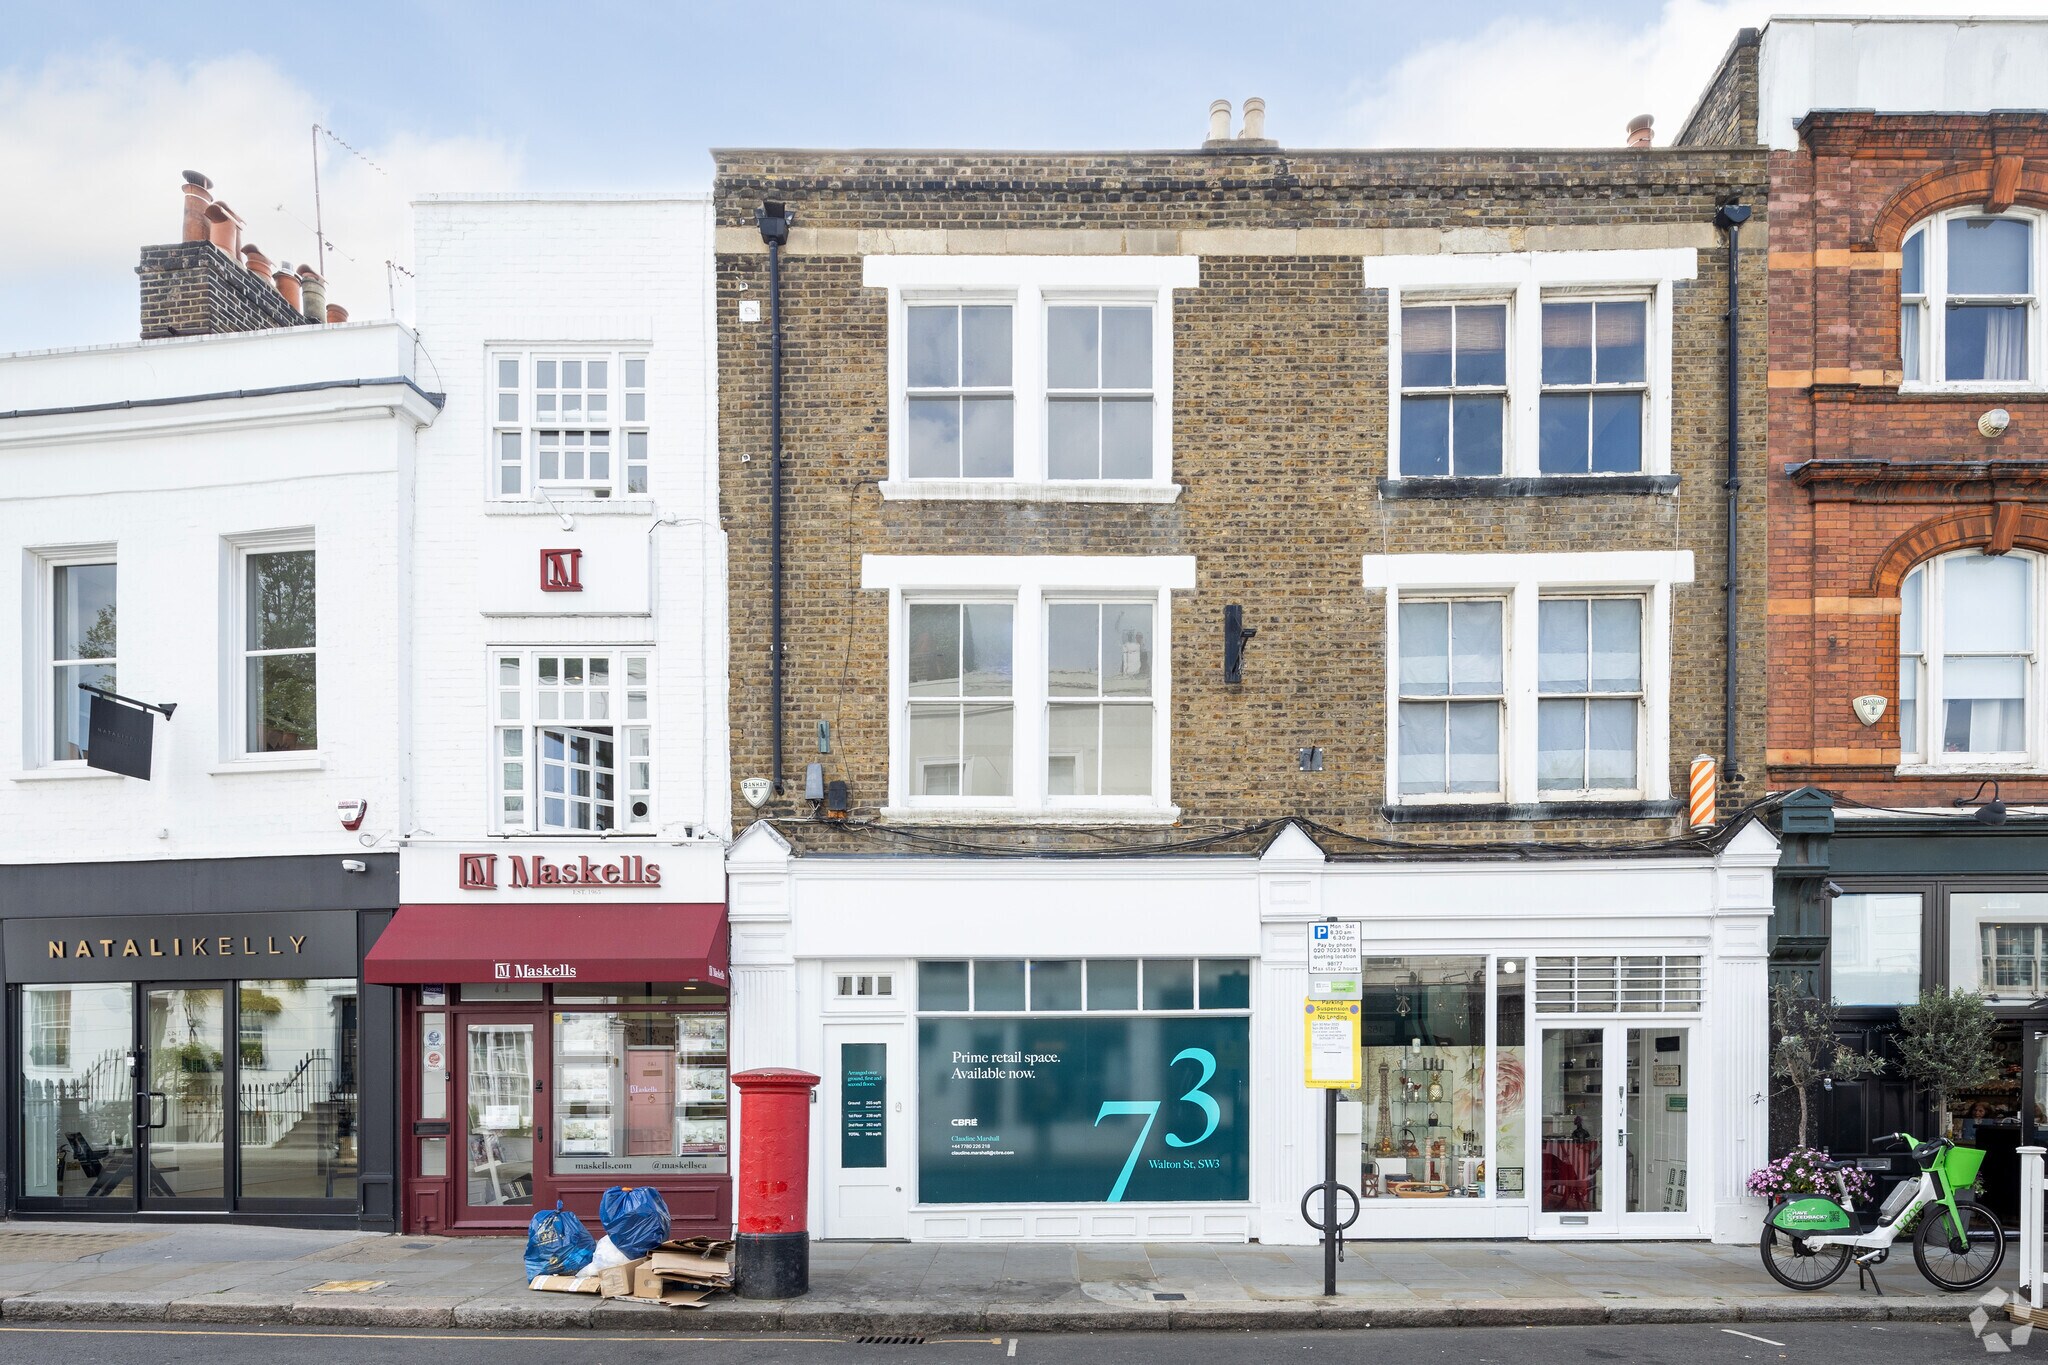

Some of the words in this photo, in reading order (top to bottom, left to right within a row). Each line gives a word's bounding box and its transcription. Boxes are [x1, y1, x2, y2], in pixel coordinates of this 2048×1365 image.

[508, 856, 662, 888] Maskells
[1318, 927, 1326, 938] P
[514, 964, 576, 978] Maskells
[952, 1051, 988, 1063] Prime
[991, 1051, 1022, 1063] retail
[1024, 1054, 1061, 1066] space.
[951, 1068, 1006, 1079] Available
[1009, 1070, 1036, 1079] now.
[951, 1118, 978, 1126] CBRE
[652, 1161, 707, 1170] @maskellsea
[1149, 1160, 1181, 1169] Walton
[1198, 1160, 1220, 1169] SW3
[1894, 1200, 1924, 1230] Lime
